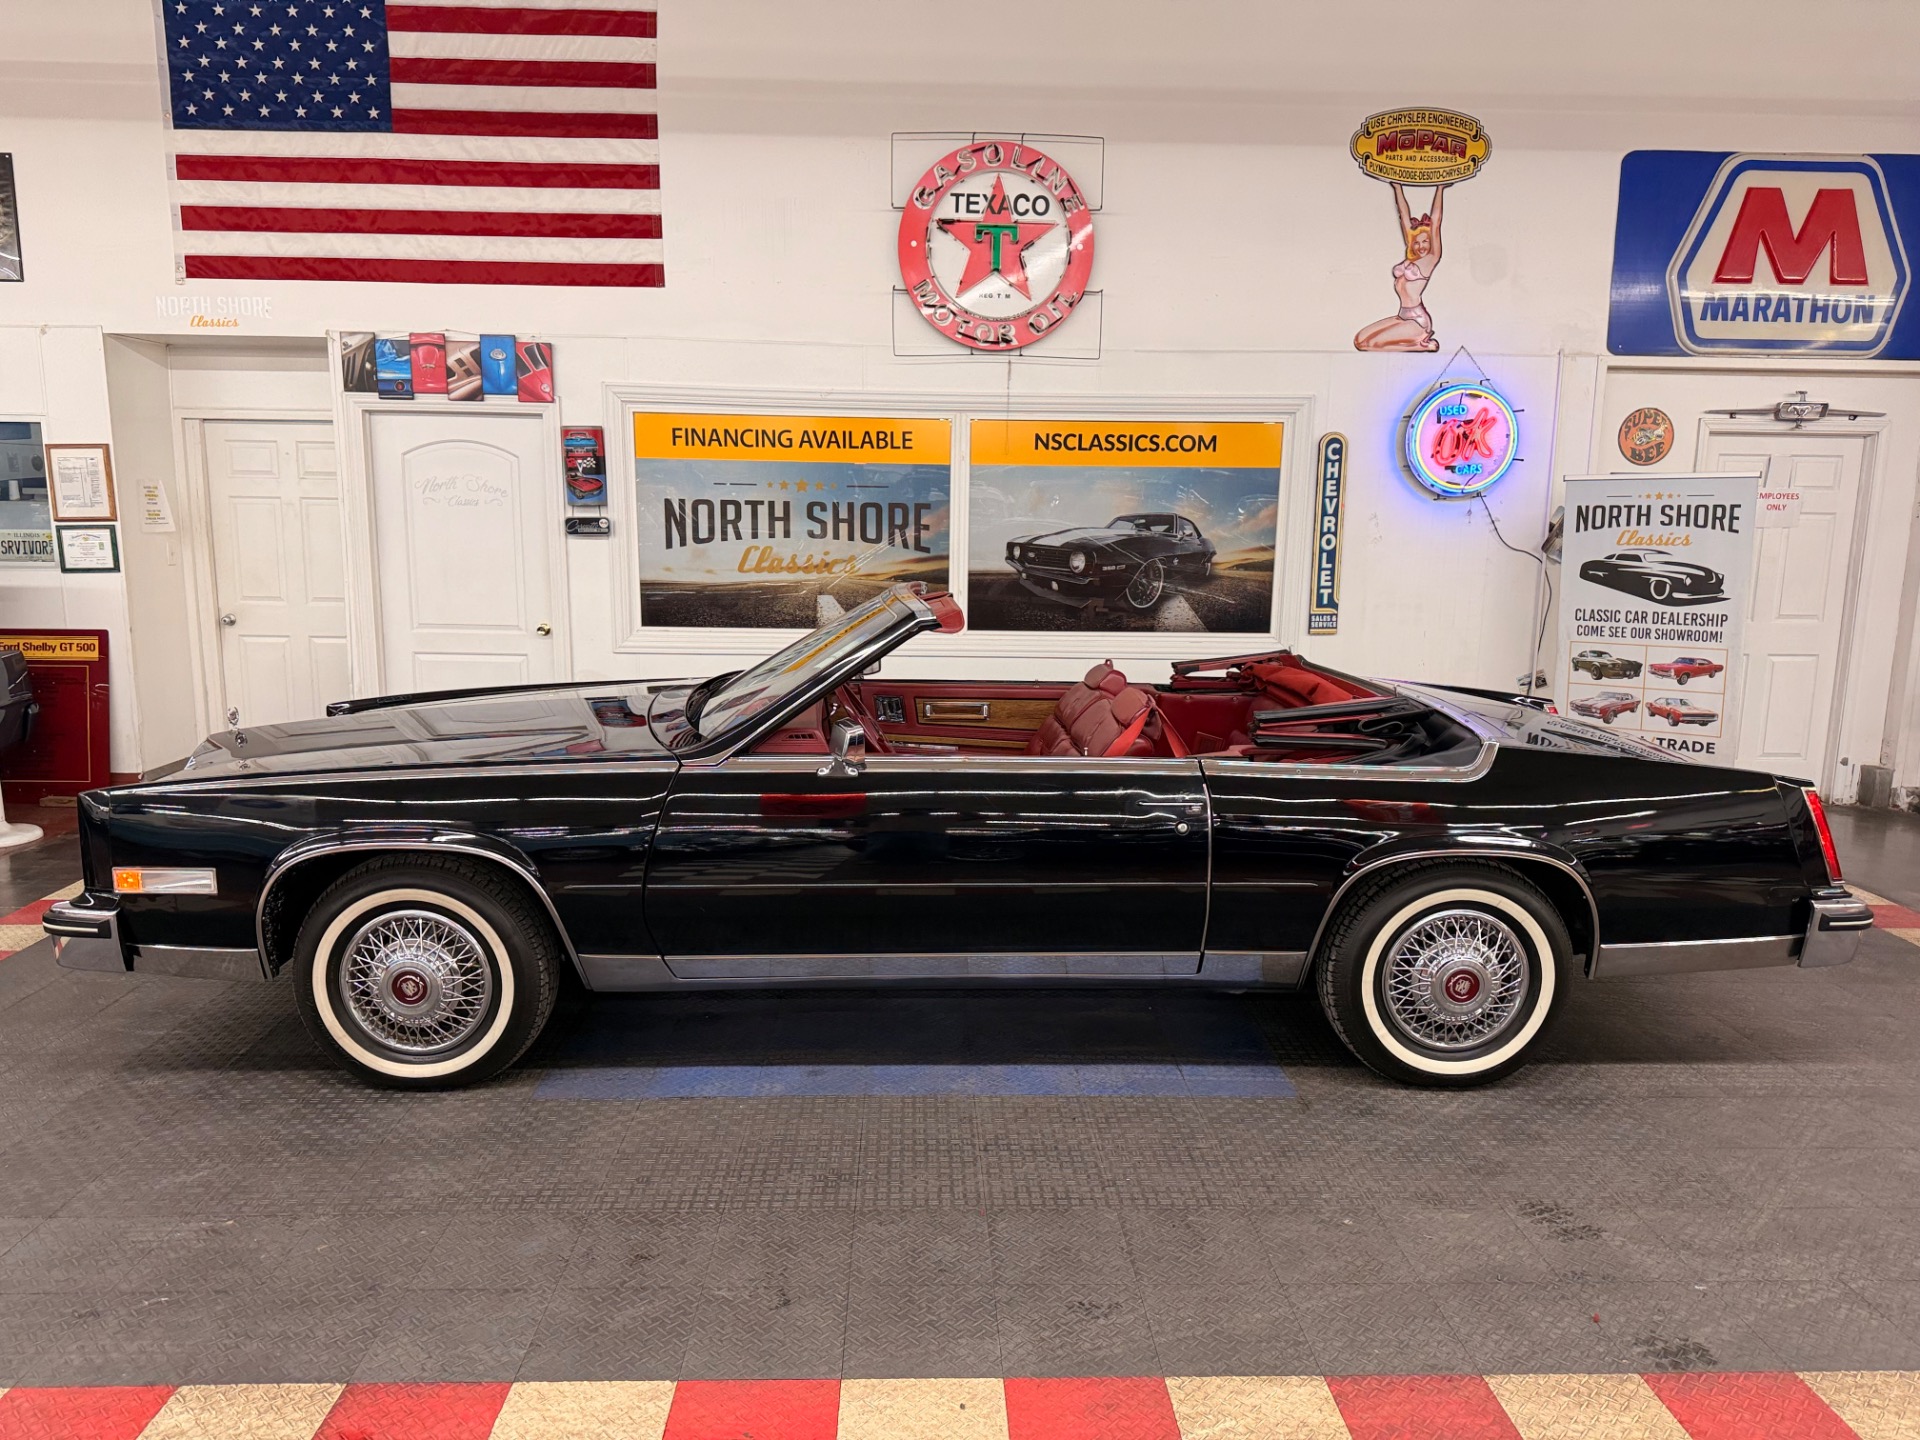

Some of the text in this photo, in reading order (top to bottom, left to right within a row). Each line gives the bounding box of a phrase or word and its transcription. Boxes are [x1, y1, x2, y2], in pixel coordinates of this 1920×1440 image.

[1370, 116, 1385, 129] USE
[1387, 112, 1427, 126] CHRYSLER
[1428, 112, 1474, 132] ENGINEERED
[1376, 128, 1468, 159] MOPAR
[1385, 154, 1458, 163] PARTS AND ACCESSORIES
[913, 143, 1085, 217] GASOLINE
[950, 192, 1050, 216] TEXACO
[974, 223, 1018, 272] T
[913, 279, 1079, 347] MOTOR OIL
[1700, 293, 1875, 324] MARATHON
[1439, 404, 1467, 415] USED
[671, 427, 913, 450] FINANCING AVAILABLE
[1034, 432, 1217, 453] NSCLASSICS.COM
[1433, 407, 1497, 466] OK
[1630, 441, 1665, 463] BEE
[1455, 464, 1483, 475] CARS
[414, 474, 509, 497] North Shore
[1757, 492, 1799, 500] MPLOYEES
[1766, 503, 1787, 511] ONLY
[664, 497, 932, 554] NORTH SHORE
[1319, 443, 1341, 605] CHEVROLET
[1575, 503, 1742, 534] NORTH SHORE
[0, 539, 49, 555] SRVIVOR
[1616, 530, 1693, 547] Classics
[737, 545, 861, 575] Classics
[1575, 608, 1728, 628] CLASSIC CAR DEALERSHIP
[1576, 625, 1723, 643] COME SEE OUR SHOWROOM!
[0, 642, 96, 654] Ford Shelby GT 500
